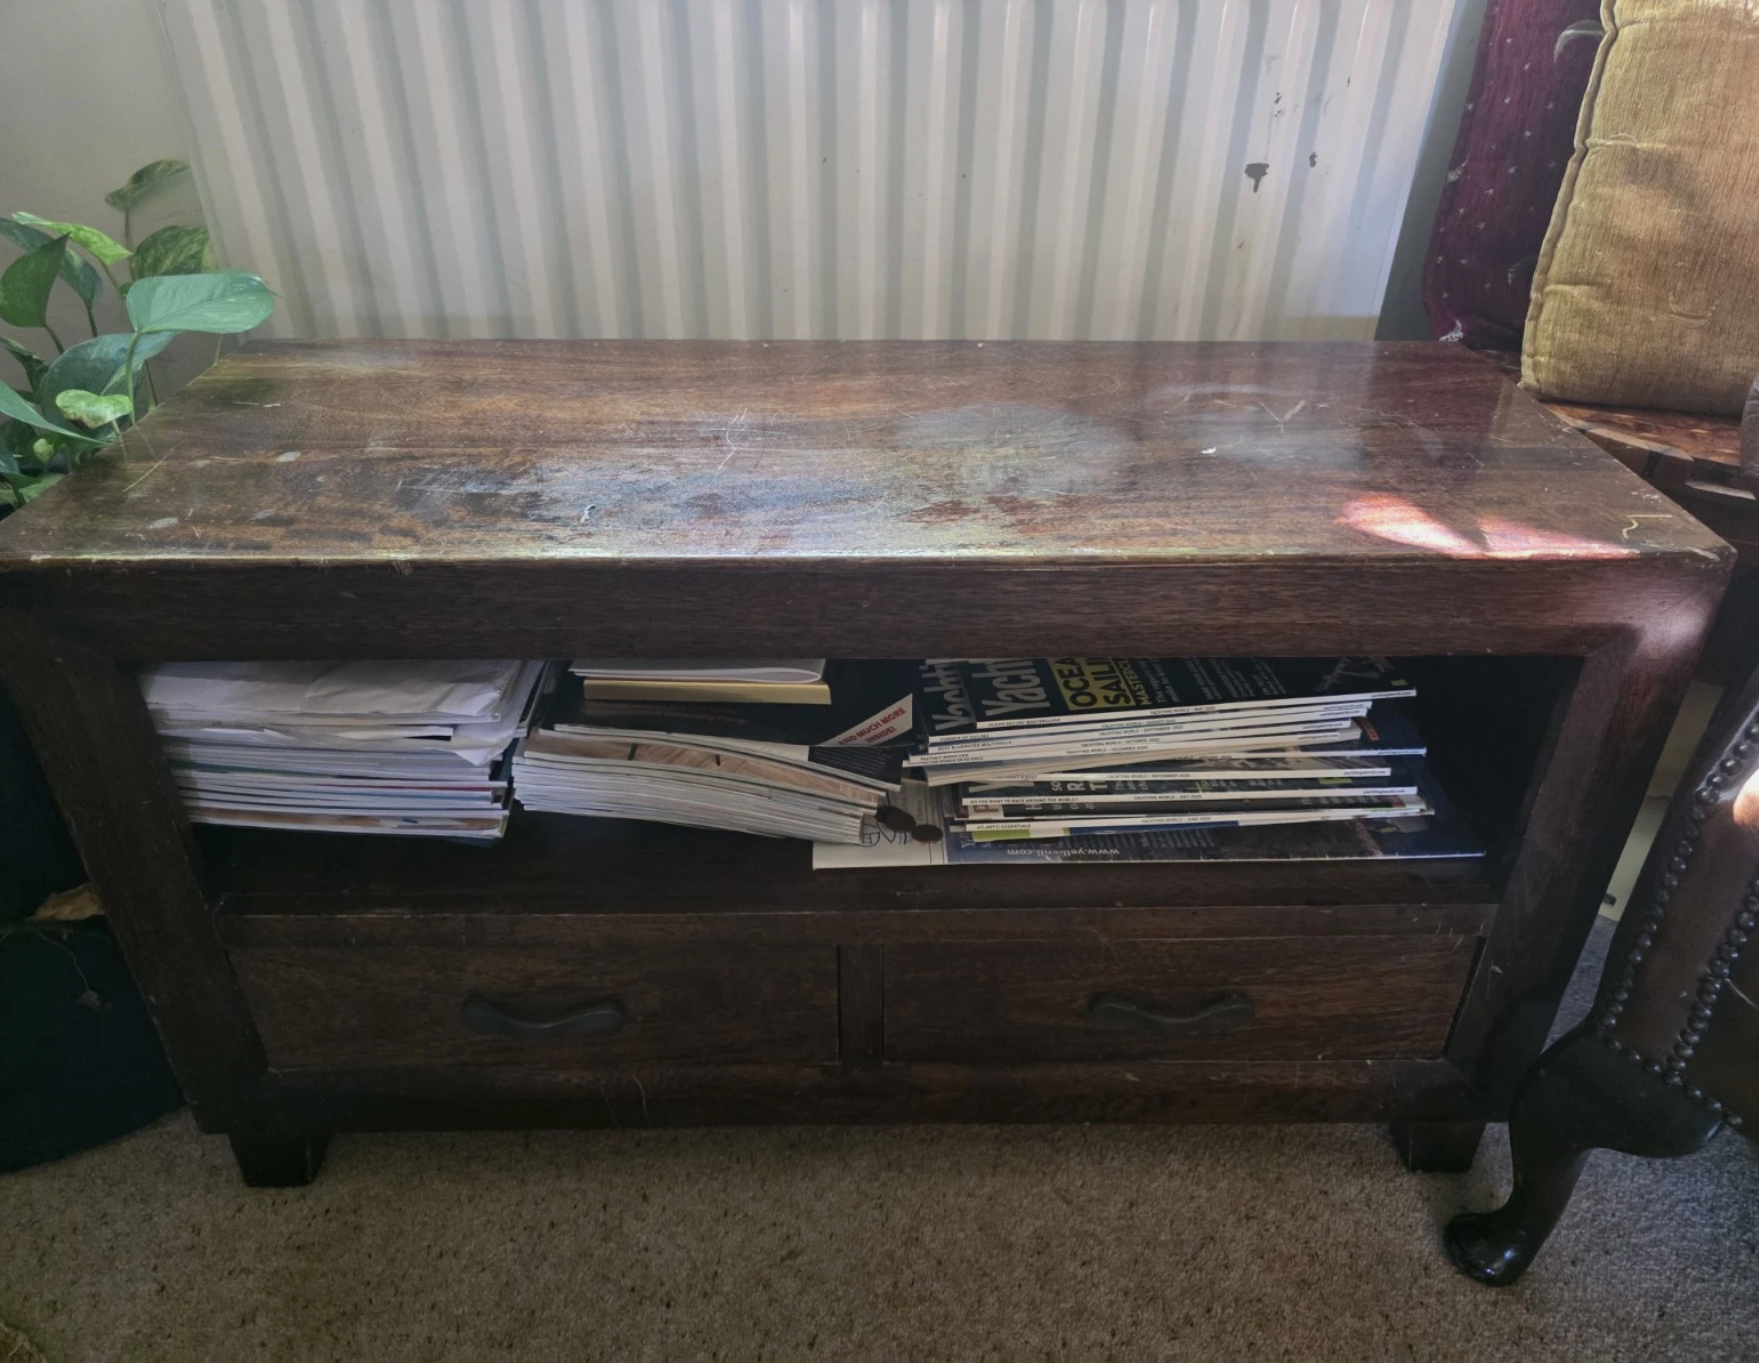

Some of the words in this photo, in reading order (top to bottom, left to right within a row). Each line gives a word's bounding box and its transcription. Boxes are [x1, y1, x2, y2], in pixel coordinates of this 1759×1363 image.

[837, 735, 858, 746] AND
[855, 721, 883, 738] MUCH
[880, 707, 906, 725] MORE
[864, 726, 897, 744] INSIDE!
